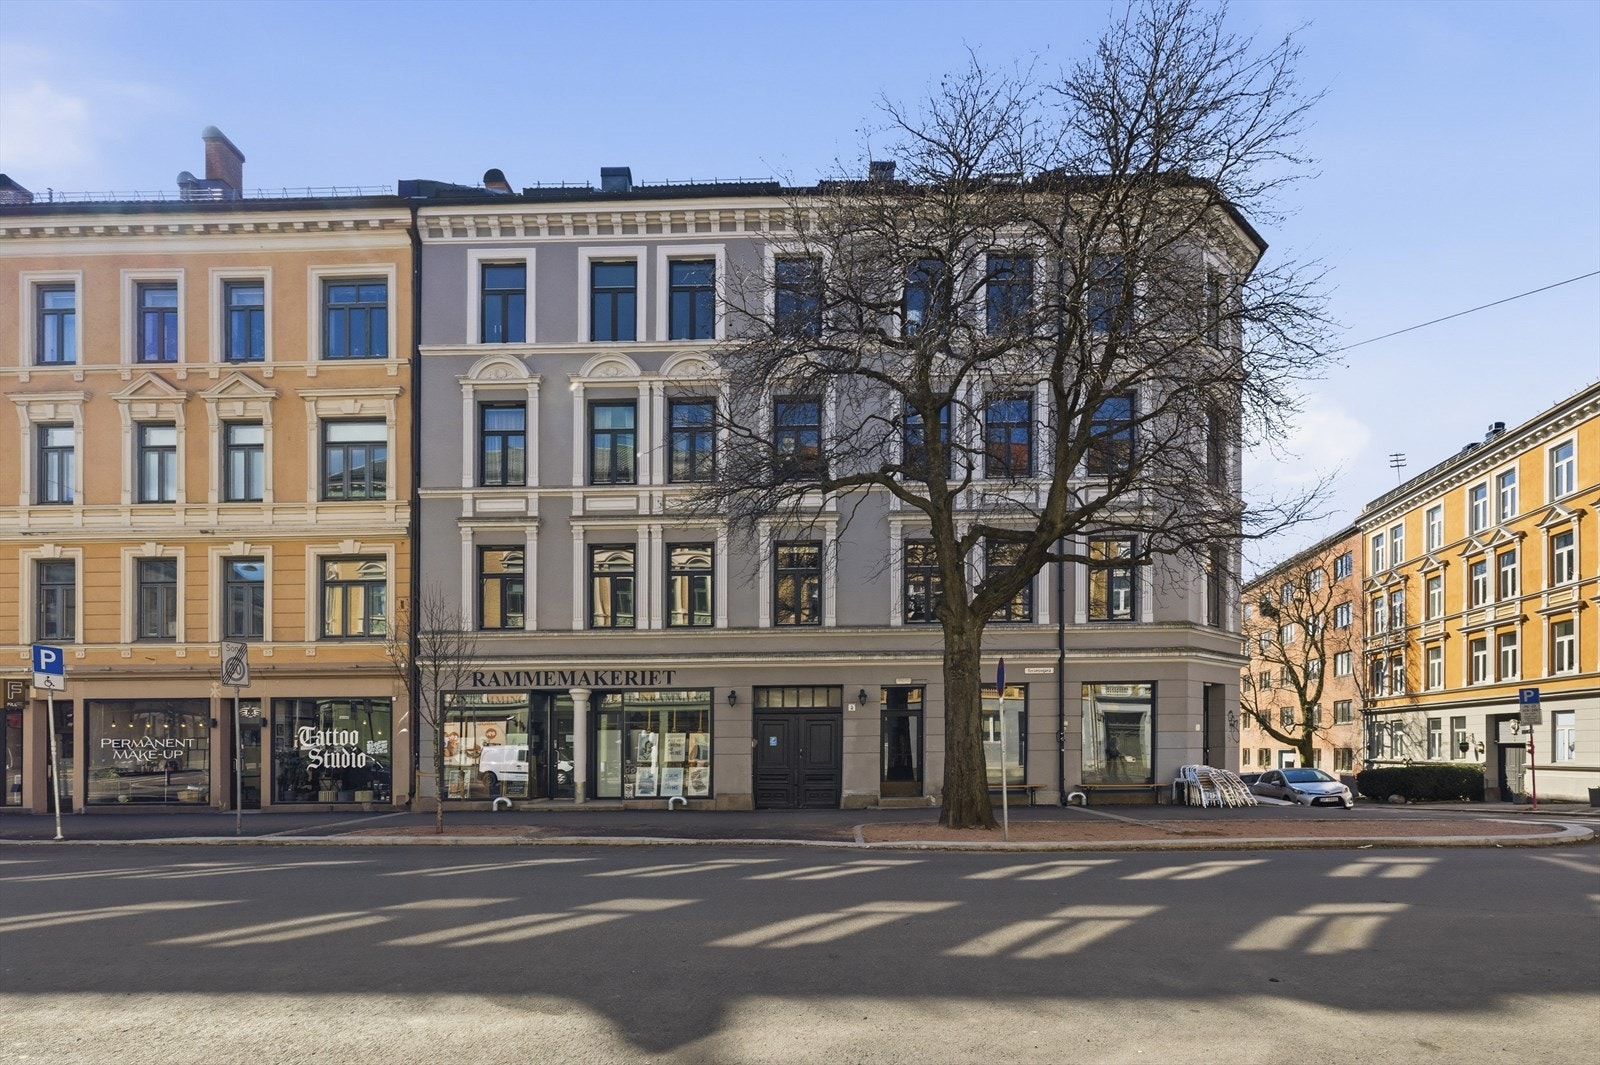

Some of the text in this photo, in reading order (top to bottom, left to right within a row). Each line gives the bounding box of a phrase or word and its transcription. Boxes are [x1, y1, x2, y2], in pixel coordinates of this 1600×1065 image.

[225, 643, 241, 653] Son
[40, 649, 56, 670] P
[471, 670, 677, 687] RAMMEMAKERIET
[7, 681, 23, 700] F
[1523, 689, 1534, 702] P
[100, 735, 195, 751] PERMANENT
[297, 726, 359, 748] Tattoo
[112, 749, 184, 761] MAKE-UP
